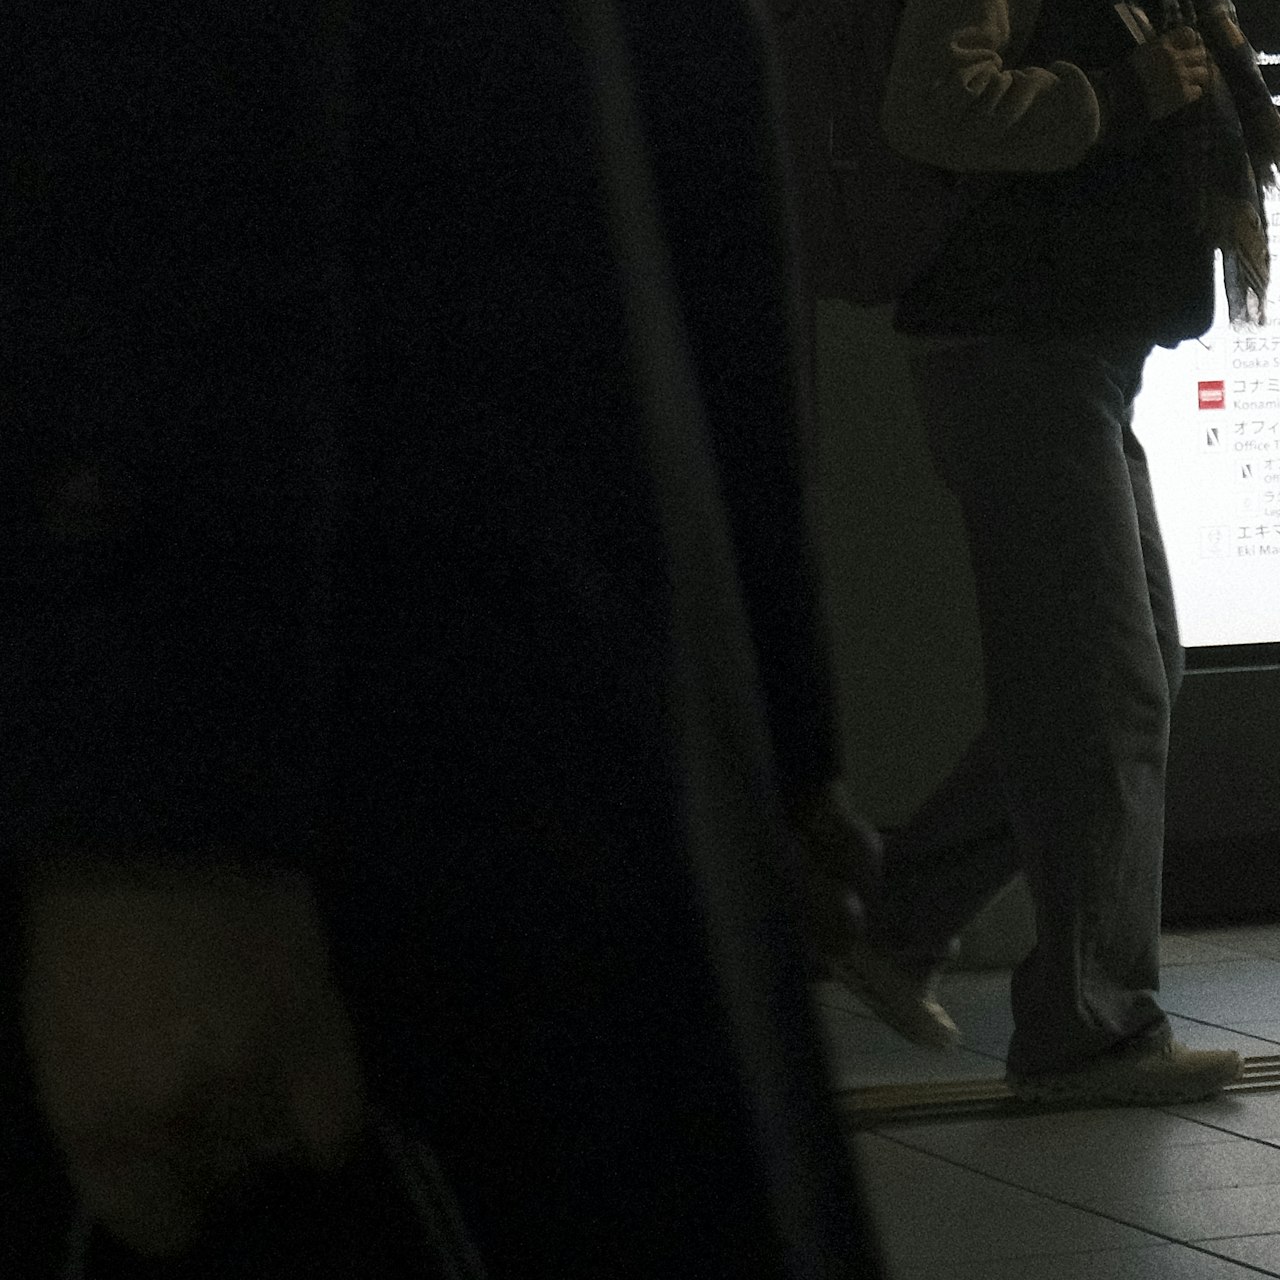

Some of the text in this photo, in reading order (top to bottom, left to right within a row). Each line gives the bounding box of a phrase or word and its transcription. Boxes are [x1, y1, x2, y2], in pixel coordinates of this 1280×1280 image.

[1232, 357, 1269, 369] Osaka
[1234, 398, 1280, 410] Konami
[1234, 440, 1270, 452] Office
[1238, 544, 1256, 557] Eki
